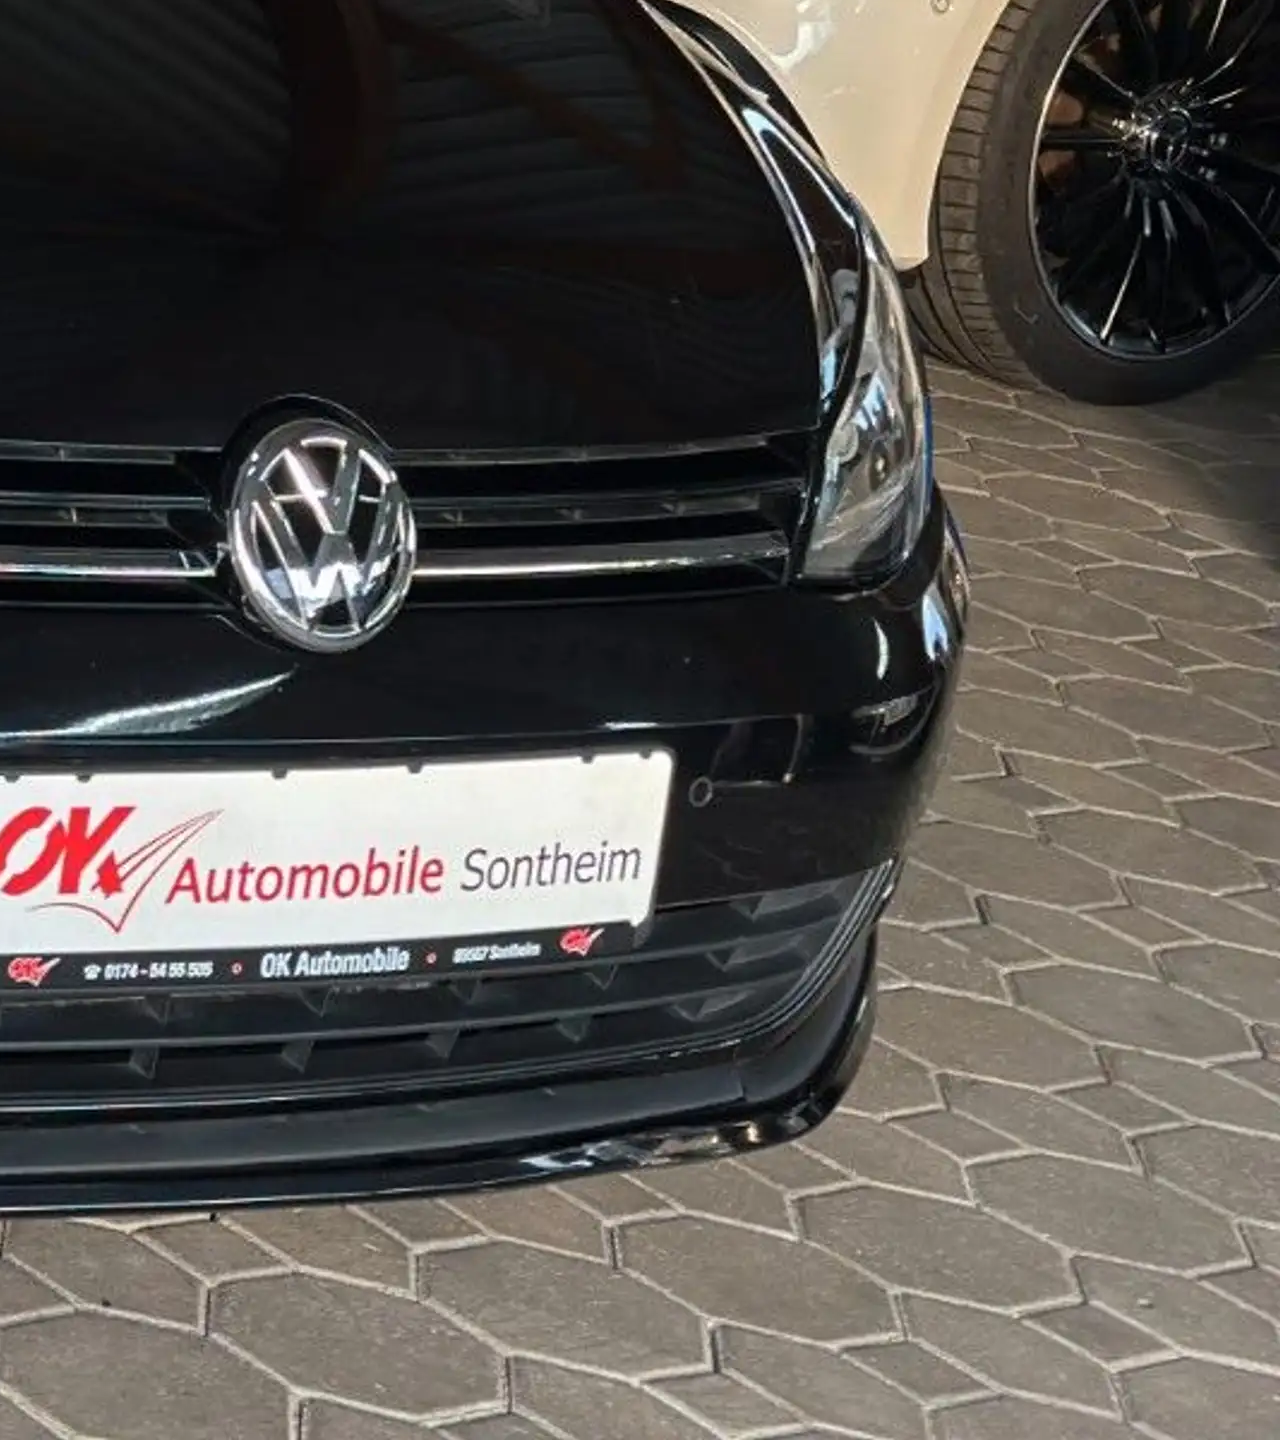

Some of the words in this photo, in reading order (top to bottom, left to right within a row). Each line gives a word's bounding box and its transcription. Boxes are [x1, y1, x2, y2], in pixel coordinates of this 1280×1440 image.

[165, 845, 444, 905] Automobile
[460, 840, 642, 892] Sontheim
[260, 952, 290, 978] OK
[293, 946, 411, 977] Automobile
